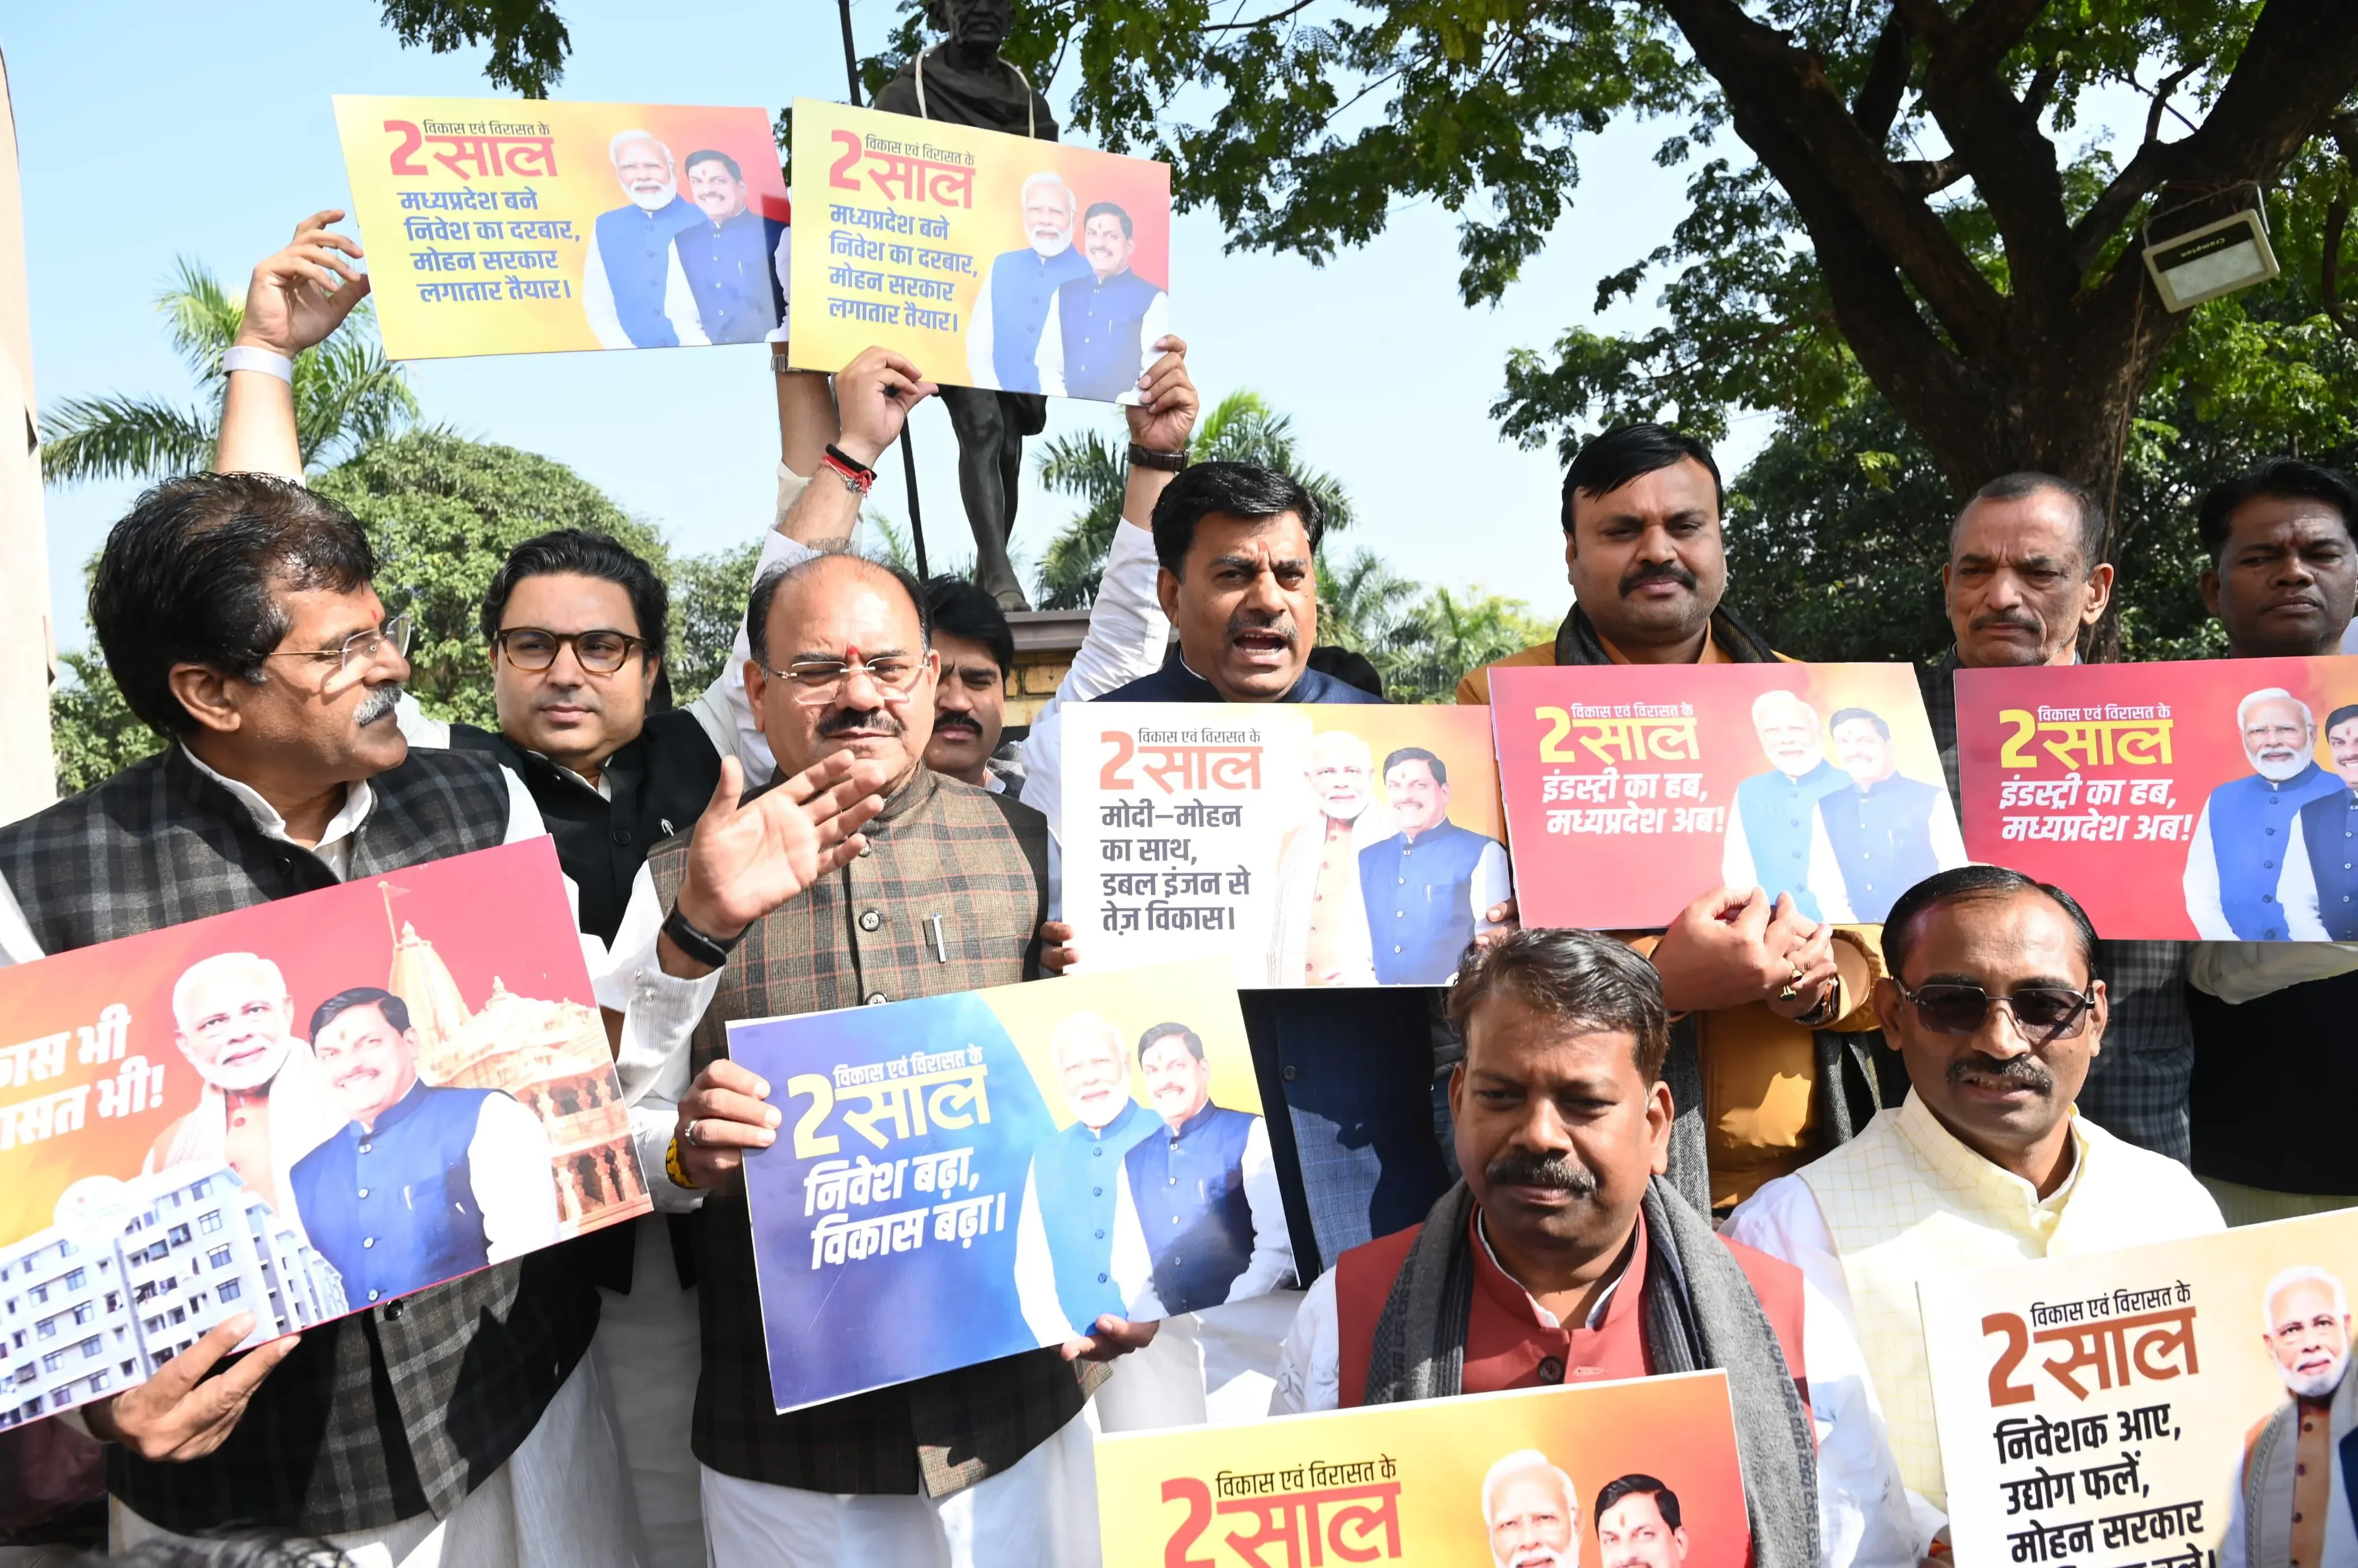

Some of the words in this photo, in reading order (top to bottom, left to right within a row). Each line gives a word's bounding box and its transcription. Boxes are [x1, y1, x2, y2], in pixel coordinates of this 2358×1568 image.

[423, 120, 464, 135] विकास
[468, 120, 486, 135] एवं
[489, 120, 535, 135] विरासत
[537, 120, 550, 135] के
[383, 120, 429, 176] 2
[425, 136, 558, 180] साल
[829, 130, 862, 191] 2
[864, 150, 976, 209] साल
[865, 134, 901, 154] विकास
[905, 142, 921, 158] एवं
[923, 143, 961, 164] विरासत
[964, 151, 975, 166] के
[397, 186, 497, 211] मध्यप्रदेश
[501, 186, 538, 210] बने
[404, 215, 469, 241] निवेश
[472, 221, 503, 240] का
[507, 220, 580, 242] दरबार,
[829, 203, 914, 235] मध्यप्रदेश
[919, 211, 949, 240] बने
[410, 246, 476, 272] मोहन
[480, 250, 558, 269] सरकार
[829, 231, 883, 262] निवेश
[889, 240, 913, 265] का
[919, 246, 977, 278] दरबार,
[2181, 237, 2225, 257] Crompton
[417, 281, 502, 303] लगातार
[505, 275, 571, 300] तैयार।
[829, 262, 884, 292] मोहन
[889, 275, 954, 301] सरकार
[828, 297, 898, 326] लगातार
[904, 302, 957, 332] तैयार।
[1571, 703, 1611, 719] विकास
[1615, 702, 1630, 719] एवं
[1633, 702, 1678, 719] विरासत
[1681, 701, 1693, 716] के
[2037, 705, 2080, 722] विकास
[2083, 703, 2102, 721] एवं
[2105, 704, 2156, 721] विरासत
[2158, 702, 2170, 719] के
[1139, 728, 1177, 743] विकास
[1181, 728, 1198, 743] एवं
[1201, 728, 1246, 743] विरासत
[1249, 728, 1261, 742] के
[1536, 707, 1575, 763] 2
[1573, 717, 1700, 765] साल
[2000, 709, 2037, 768] 2
[2038, 719, 2173, 771] साल
[1100, 730, 1135, 790] 2
[1139, 746, 1263, 794] साल
[1542, 766, 1618, 803] इंडस्ट्री
[1624, 774, 1657, 798] का
[1664, 773, 1707, 802] हब,
[1999, 772, 2083, 810] इंडस्ट्री
[2086, 780, 2122, 805] का
[2130, 779, 2175, 809] हब,
[1546, 801, 1667, 836] मध्यप्रदेश
[1671, 806, 1724, 834] अब!
[2002, 808, 2130, 842] मध्यप्रदेश
[2133, 814, 2192, 841] अब!
[1100, 839, 1135, 861] का
[1138, 839, 1197, 865] साथ,
[1101, 873, 1156, 897] डबल
[1163, 866, 1222, 897] इंजन
[1227, 865, 1250, 895] से
[1101, 900, 1140, 935] तेज़
[1145, 900, 1235, 930] विकास।
[77, 1002, 132, 1064] भी
[834, 1061, 883, 1087] विकास
[887, 1057, 907, 1079] एवं
[910, 1050, 965, 1076] विरासत
[966, 1043, 983, 1068] के
[96, 1055, 165, 1118] भी!
[786, 1073, 840, 1159] 2
[835, 1064, 991, 1149] साल
[804, 1155, 908, 1217] निवेश
[911, 1147, 978, 1201] बढ़ा,
[811, 1209, 924, 1270] विकास
[934, 1190, 1006, 1248] बढ़ा।
[2030, 1301, 2083, 1327] विकास
[2086, 1293, 2109, 1318] एवं
[2113, 1286, 2172, 1314] विरासत
[2175, 1280, 2190, 1304] के
[1982, 1312, 2035, 1408] 2
[2033, 1307, 2200, 1401] साल
[1993, 1415, 2108, 1464] निवेशक
[2117, 1404, 2181, 1443] आए,
[1215, 1469, 1275, 1498] विकास
[1280, 1461, 1305, 1493] एवं
[1308, 1459, 1375, 1490] विरासत
[1379, 1453, 1397, 1479] के
[2000, 1467, 2075, 1516] उद्योग
[2080, 1450, 2149, 1499] फलें,
[1160, 1477, 1215, 1568] 2
[1216, 1483, 1402, 1568] साल
[2007, 1519, 2093, 1563] मोहन
[2098, 1501, 2204, 1546] सरकार
